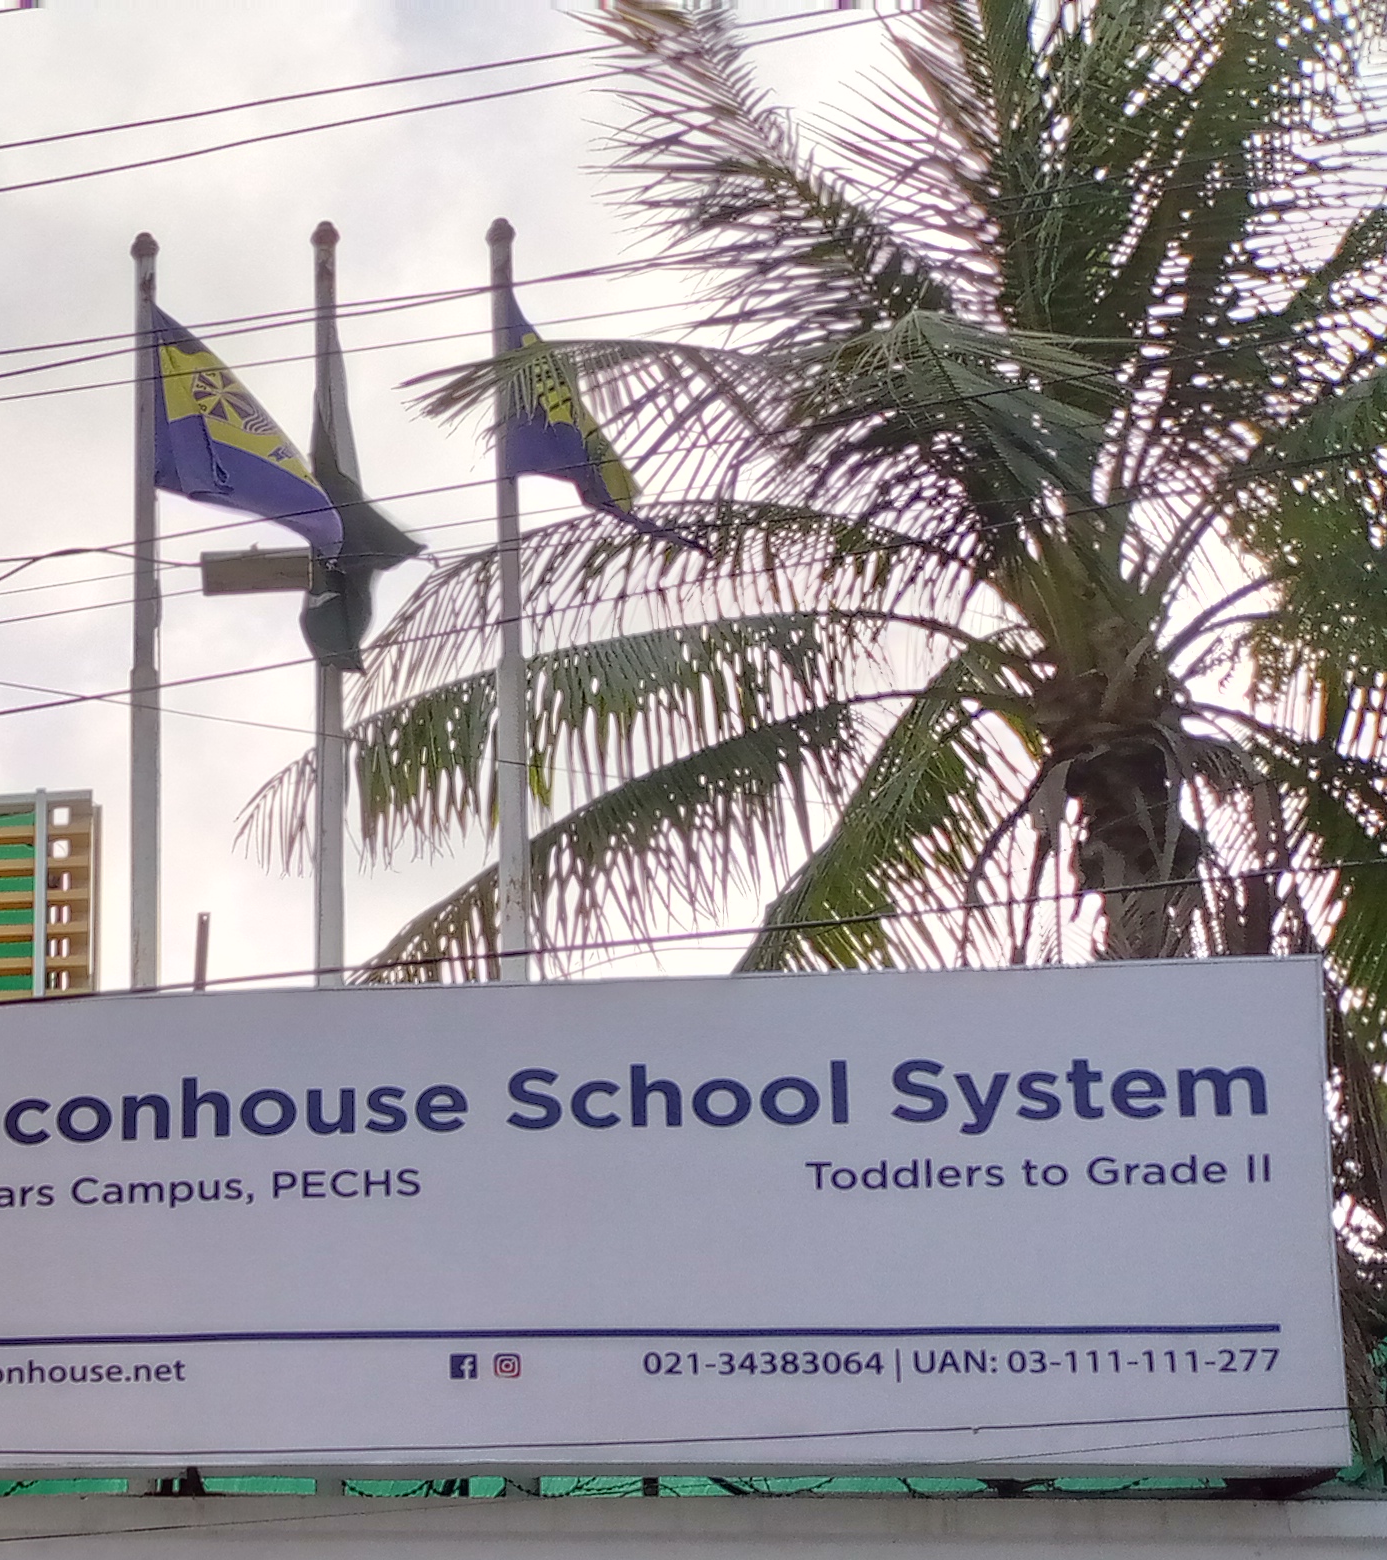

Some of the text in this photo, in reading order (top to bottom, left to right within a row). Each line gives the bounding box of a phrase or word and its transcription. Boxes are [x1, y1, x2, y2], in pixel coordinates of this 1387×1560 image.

[506, 1060, 849, 1132] School
[891, 1059, 1268, 1136] System
[70, 1173, 256, 1209] Campus,
[273, 1168, 422, 1199] PECHS
[806, 1158, 1004, 1191] Toddlers
[1022, 1160, 1069, 1187] to
[1087, 1155, 1227, 1186] Grade
[642, 1350, 886, 1377] 021-34383064
[913, 1349, 999, 1375] UAN:
[1008, 1347, 1281, 1375] 03-111-111-277
